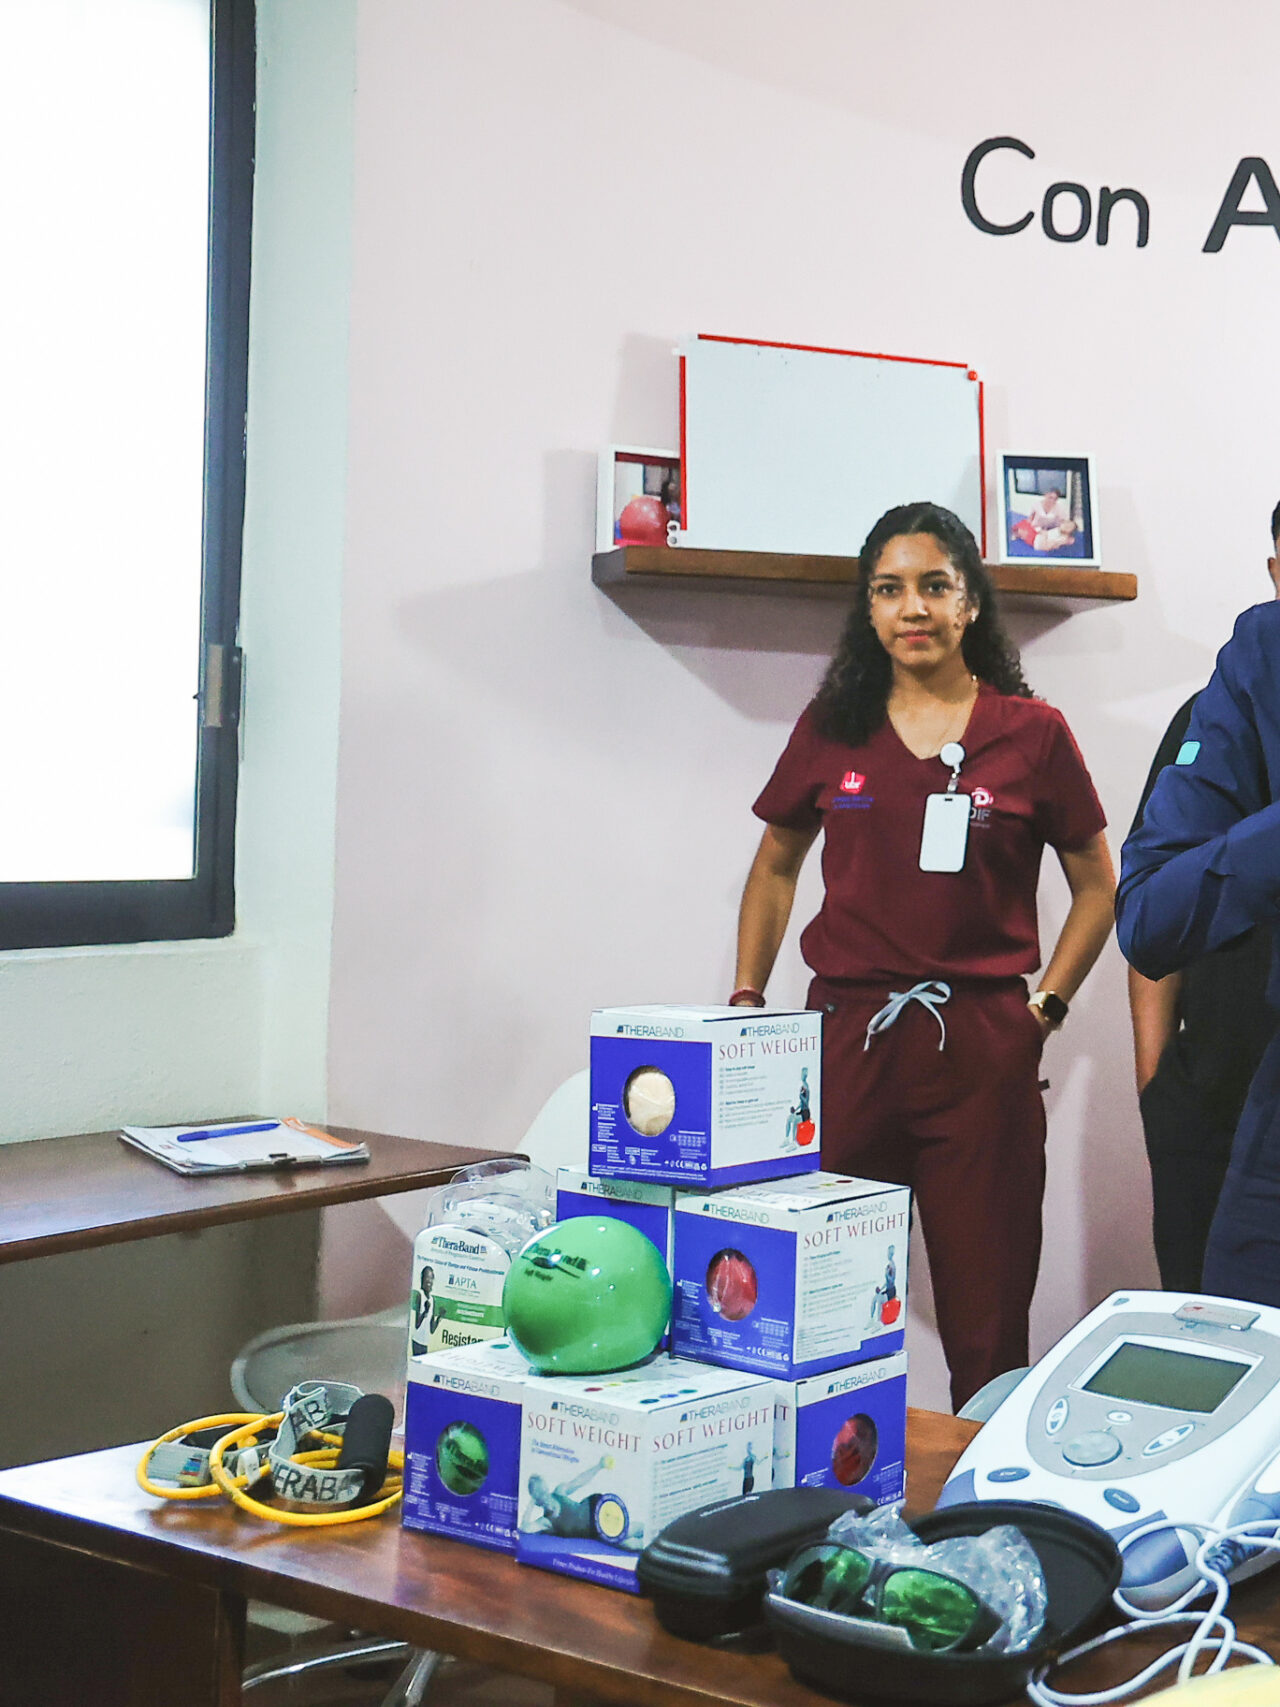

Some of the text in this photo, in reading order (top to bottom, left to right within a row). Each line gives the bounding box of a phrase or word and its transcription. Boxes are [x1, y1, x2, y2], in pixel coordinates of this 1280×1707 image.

[961, 136, 1150, 248] Con
[623, 1024, 685, 1039] THERABAND
[746, 1022, 800, 1037] THERABAND
[718, 1035, 818, 1060] SOFT WEIGHT
[709, 1203, 770, 1224] THERABAND
[834, 1200, 888, 1222] THERABAND
[803, 1211, 906, 1250] SOFT WEIGHT
[454, 1276, 477, 1290] APTA
[439, 1374, 501, 1397] THERABAND
[833, 1367, 887, 1394] THERABAND
[558, 1402, 620, 1426] THERABAND
[687, 1396, 750, 1422] THERABAND
[527, 1411, 567, 1437] SOFT
[572, 1421, 642, 1453] WEIGHT
[653, 1426, 696, 1453] SOFT
[701, 1407, 770, 1439] WEIGHT
